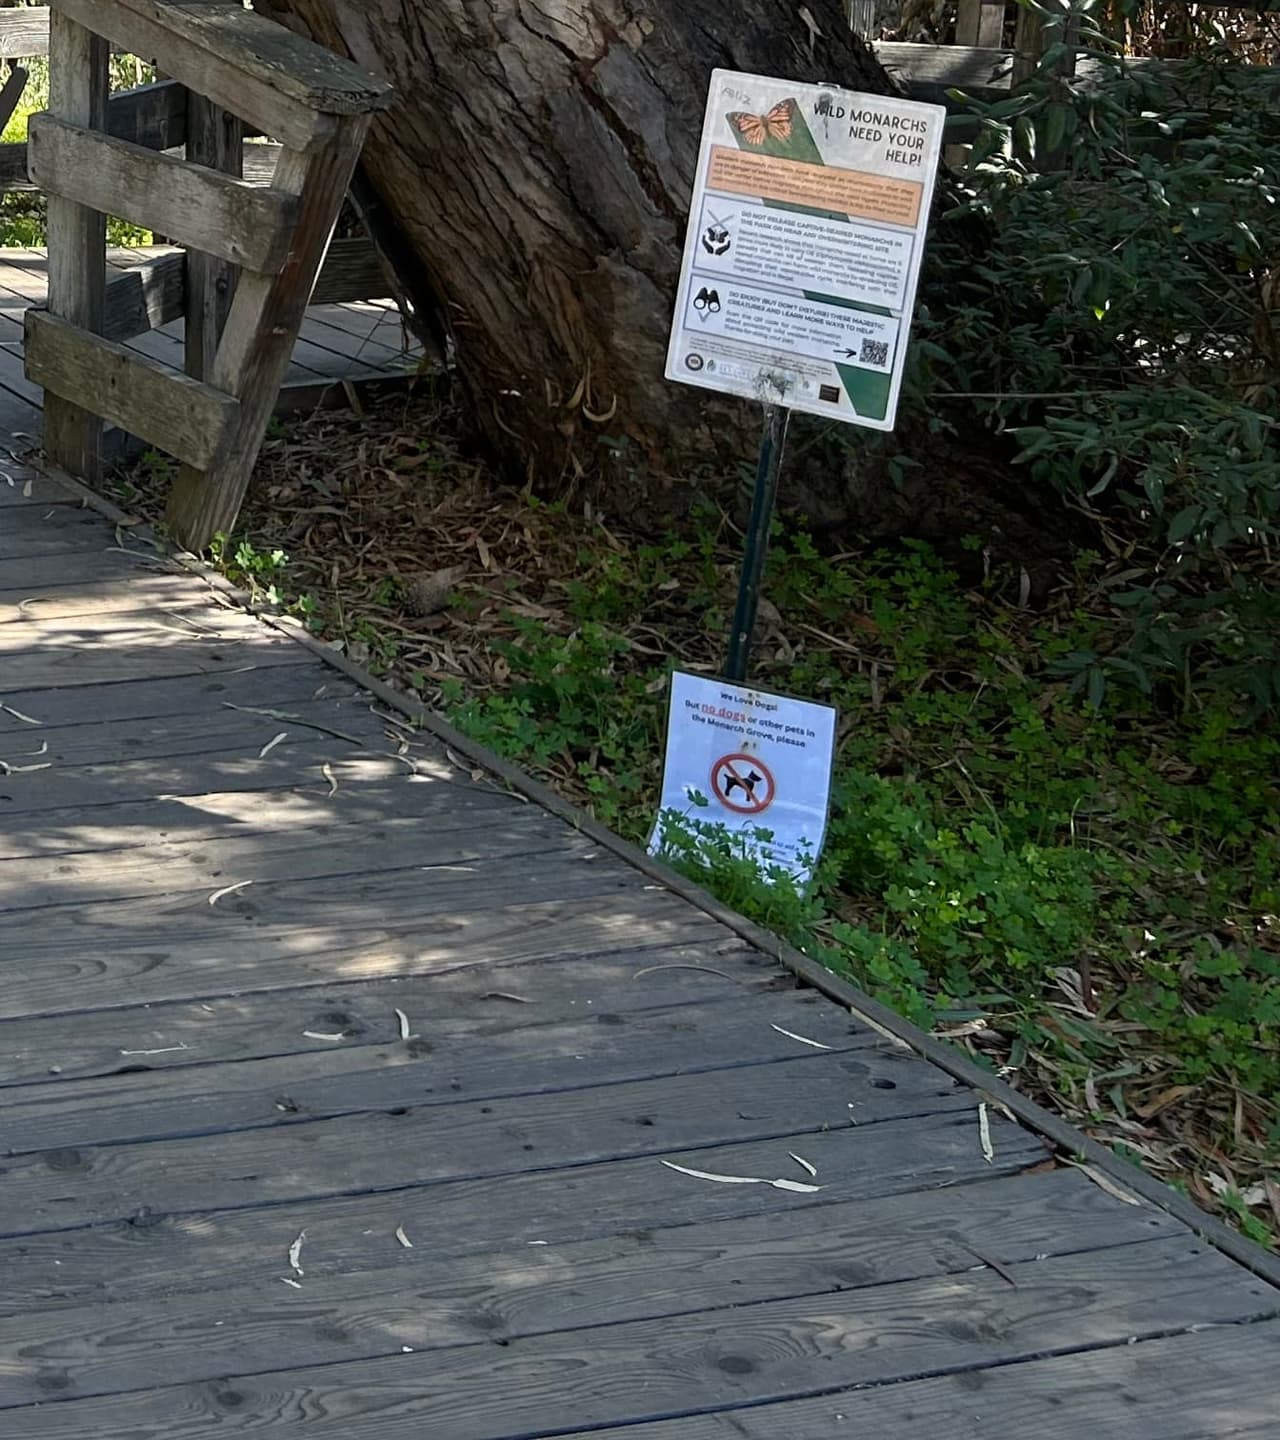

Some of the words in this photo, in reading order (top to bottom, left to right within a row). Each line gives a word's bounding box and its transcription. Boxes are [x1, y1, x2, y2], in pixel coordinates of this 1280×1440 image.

[814, 103, 846, 119] WILD
[850, 109, 928, 133] MONARCHS
[848, 126, 883, 143] NEED
[889, 133, 925, 150] YOUR
[885, 150, 923, 167] HELP!
[720, 692, 733, 701] We
[734, 695, 753, 706] Love
[754, 700, 778, 712] Dogs!
[685, 700, 700, 709] But
[701, 703, 719, 715] no
[718, 706, 746, 723] dogs
[758, 718, 783, 730] other
[785, 725, 805, 736] pets
[806, 728, 815, 737] in
[692, 713, 706, 723] the
[707, 718, 744, 733] Monarch
[746, 728, 775, 742] Grove,
[776, 735, 806, 747] please
